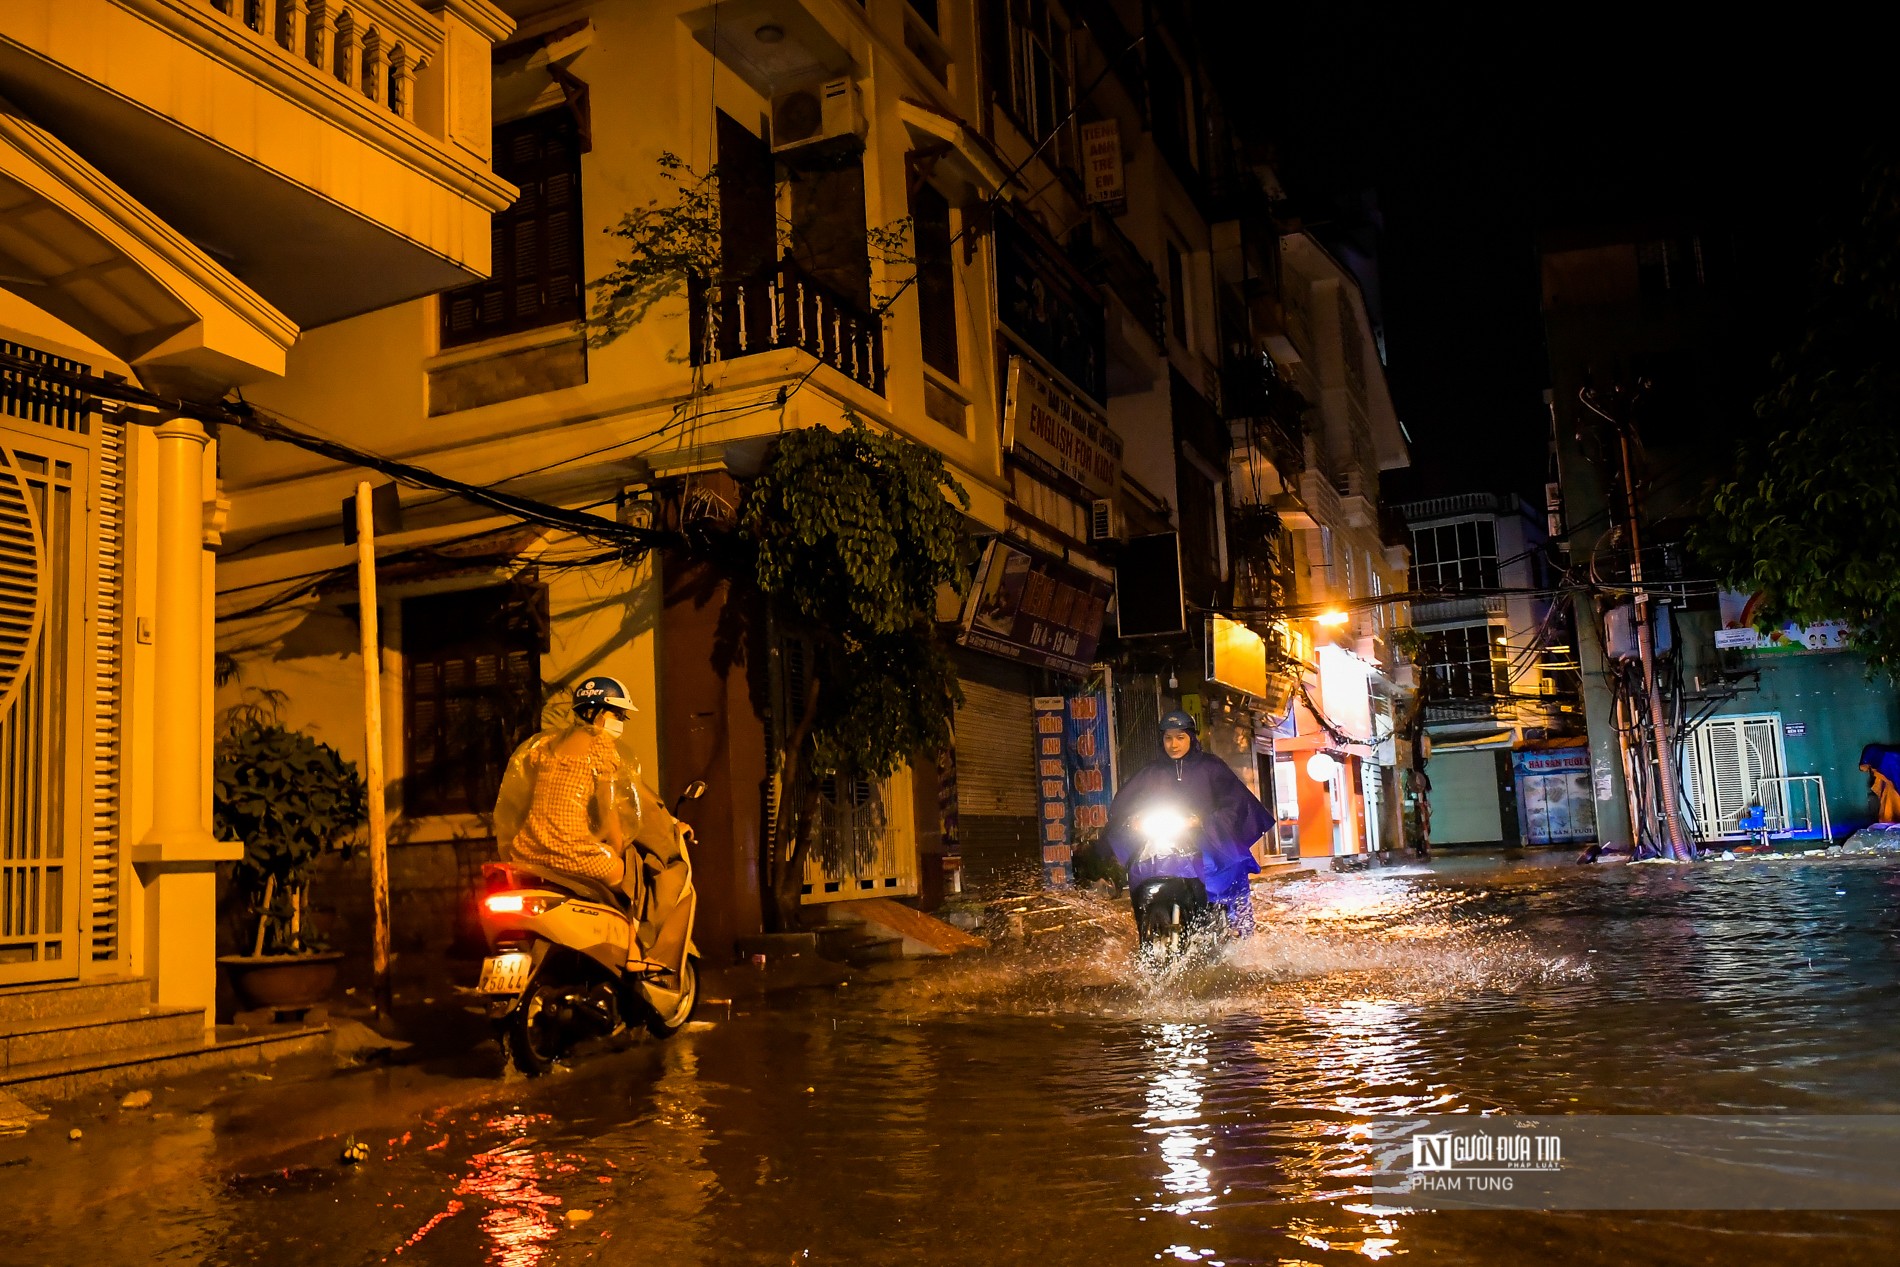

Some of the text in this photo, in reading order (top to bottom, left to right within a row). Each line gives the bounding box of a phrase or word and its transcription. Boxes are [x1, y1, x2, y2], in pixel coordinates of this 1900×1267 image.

[1029, 402, 1073, 459] ENGLISH
[1074, 437, 1093, 473] FOR
[1093, 450, 1115, 487] KIDS
[576, 688, 605, 698] Casper
[1042, 737, 1061, 756] ANH
[572, 907, 599, 916] LEAD
